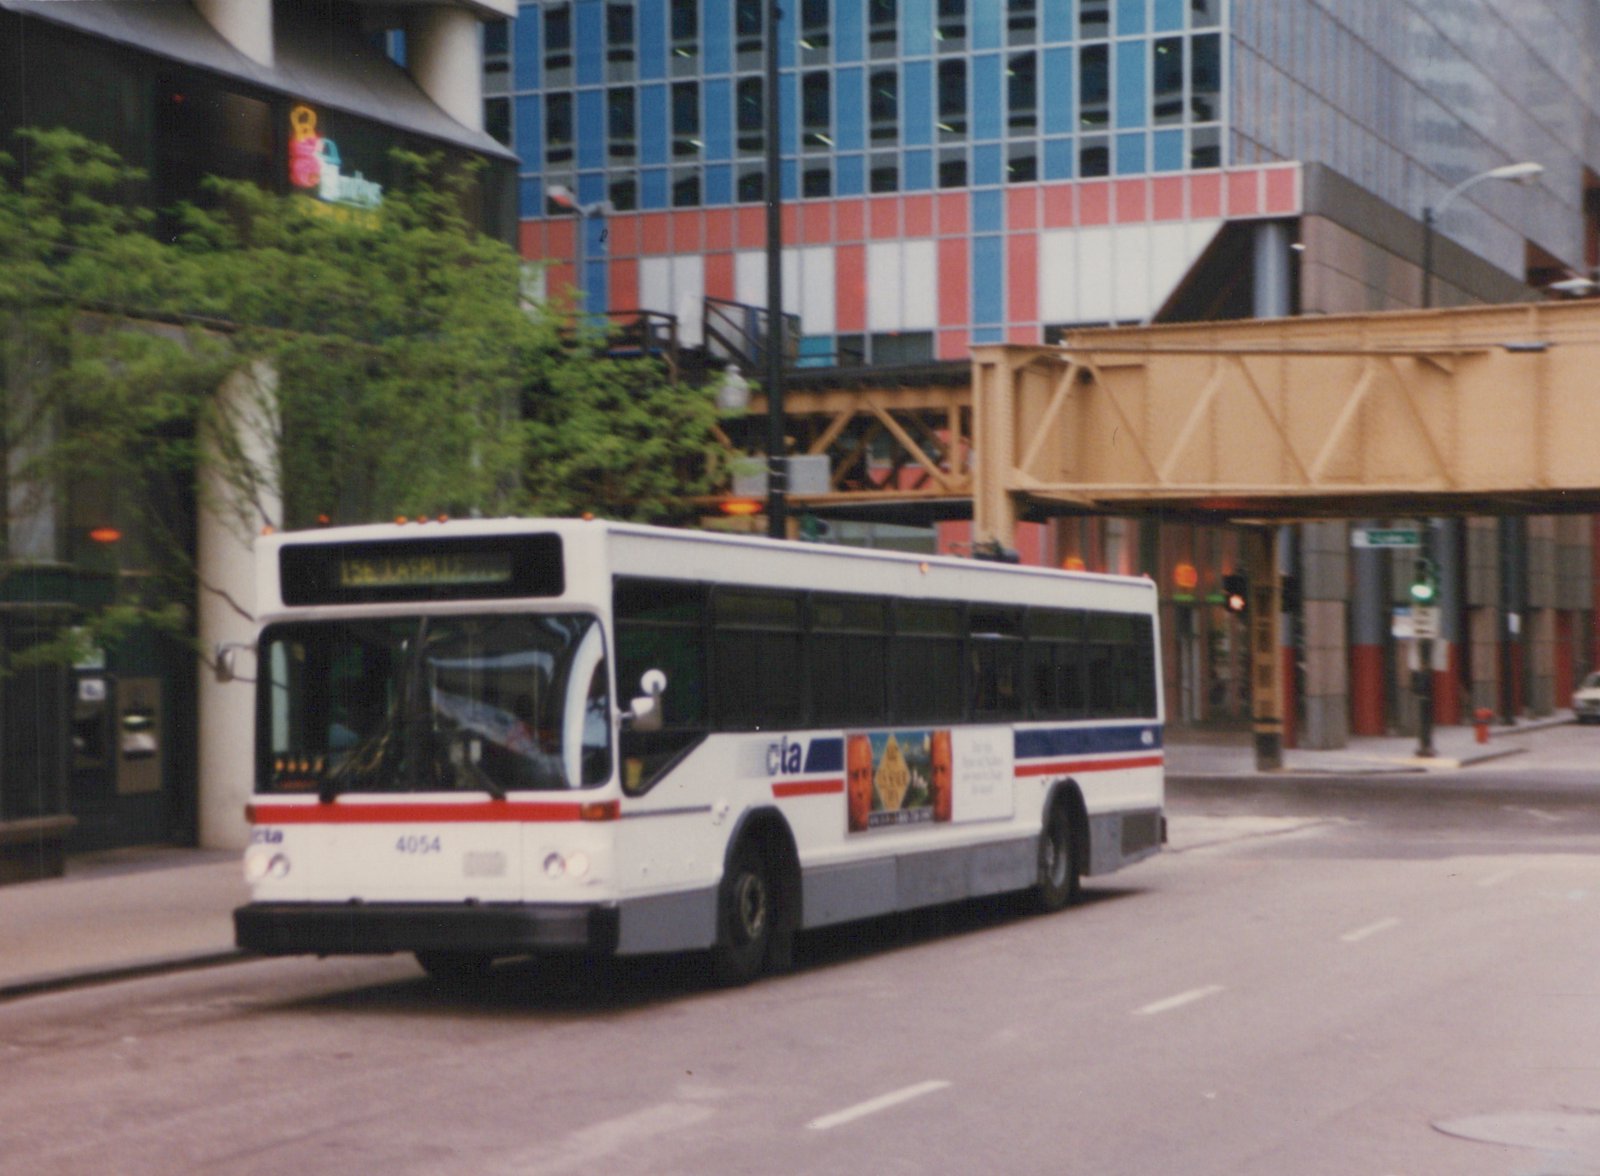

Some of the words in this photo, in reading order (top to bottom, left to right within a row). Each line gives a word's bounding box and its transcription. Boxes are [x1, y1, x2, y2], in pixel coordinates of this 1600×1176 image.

[766, 734, 802, 776] cta
[249, 827, 283, 843] cta
[395, 835, 442, 853] 4054
